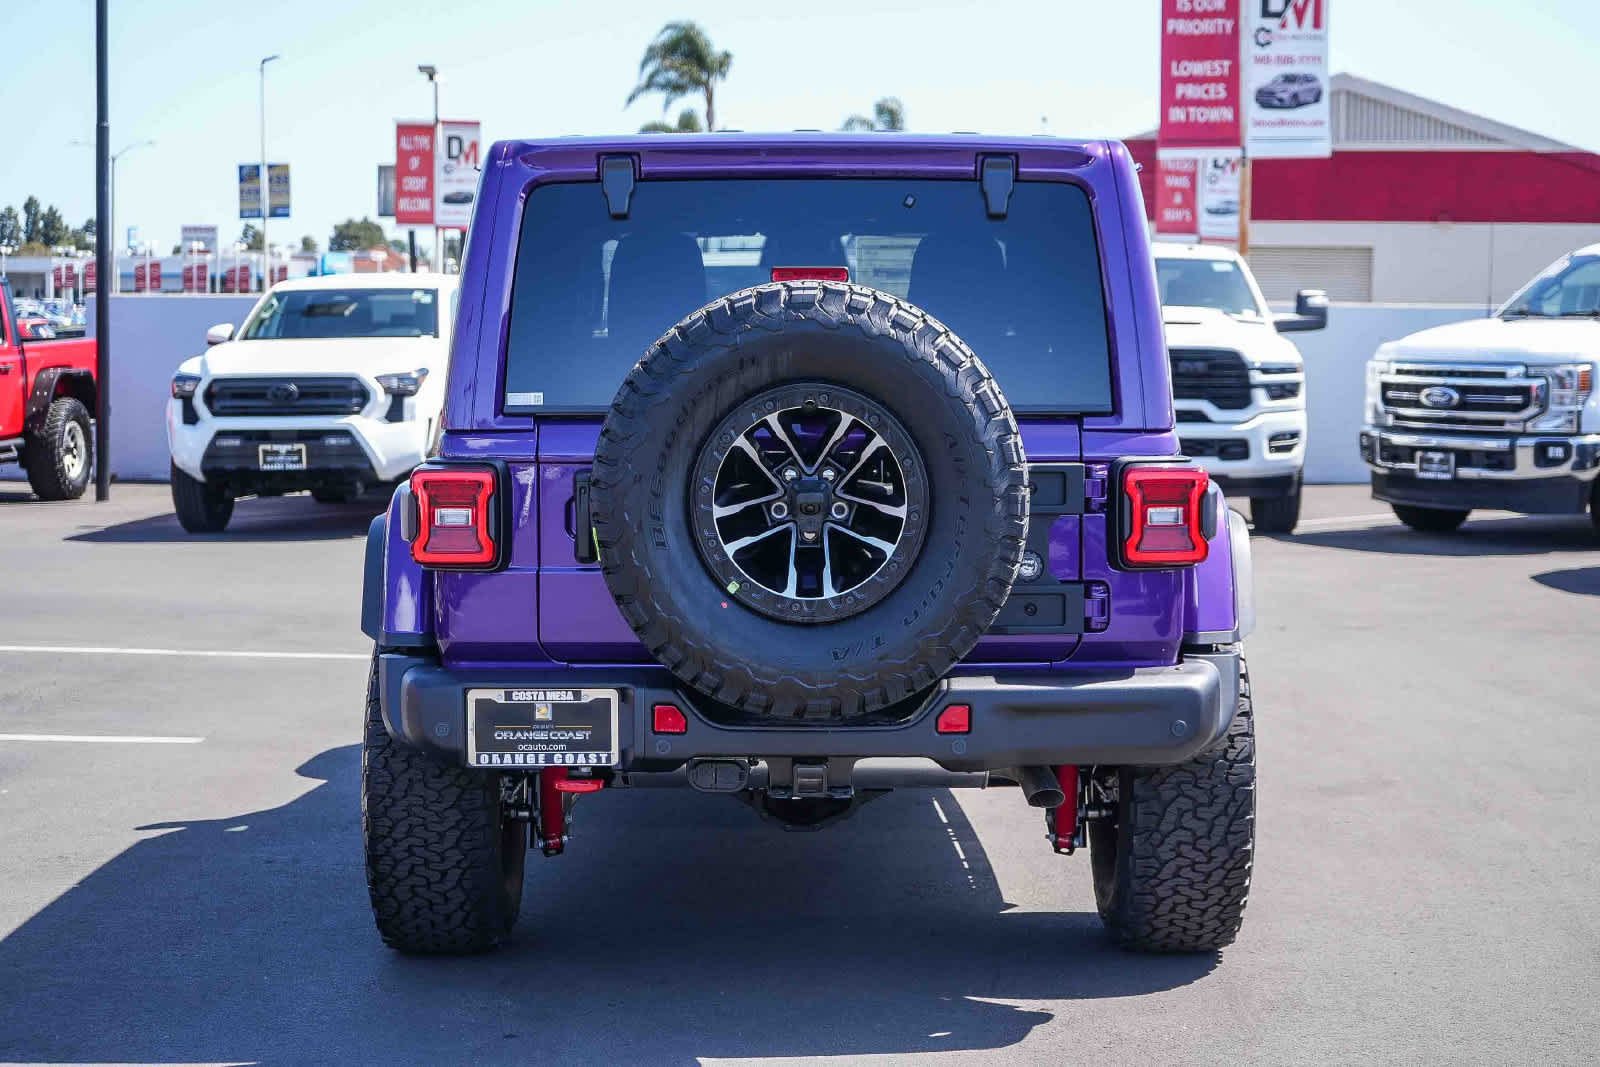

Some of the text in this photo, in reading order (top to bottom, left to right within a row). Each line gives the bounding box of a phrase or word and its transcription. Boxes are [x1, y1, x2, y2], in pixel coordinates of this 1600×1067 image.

[1193, 0, 1226, 11] OUR
[1167, 18, 1234, 34] PRIORITY
[1171, 60, 1232, 76] LOWEST
[1175, 83, 1227, 100] PRICES
[1168, 107, 1186, 122] IN
[1189, 107, 1234, 123] TOWN
[512, 690, 574, 701] COSTA MESA
[494, 730, 592, 740] ORANGE COAST
[517, 743, 567, 751] ocauto.com
[479, 753, 609, 764] ORANGE COAST
